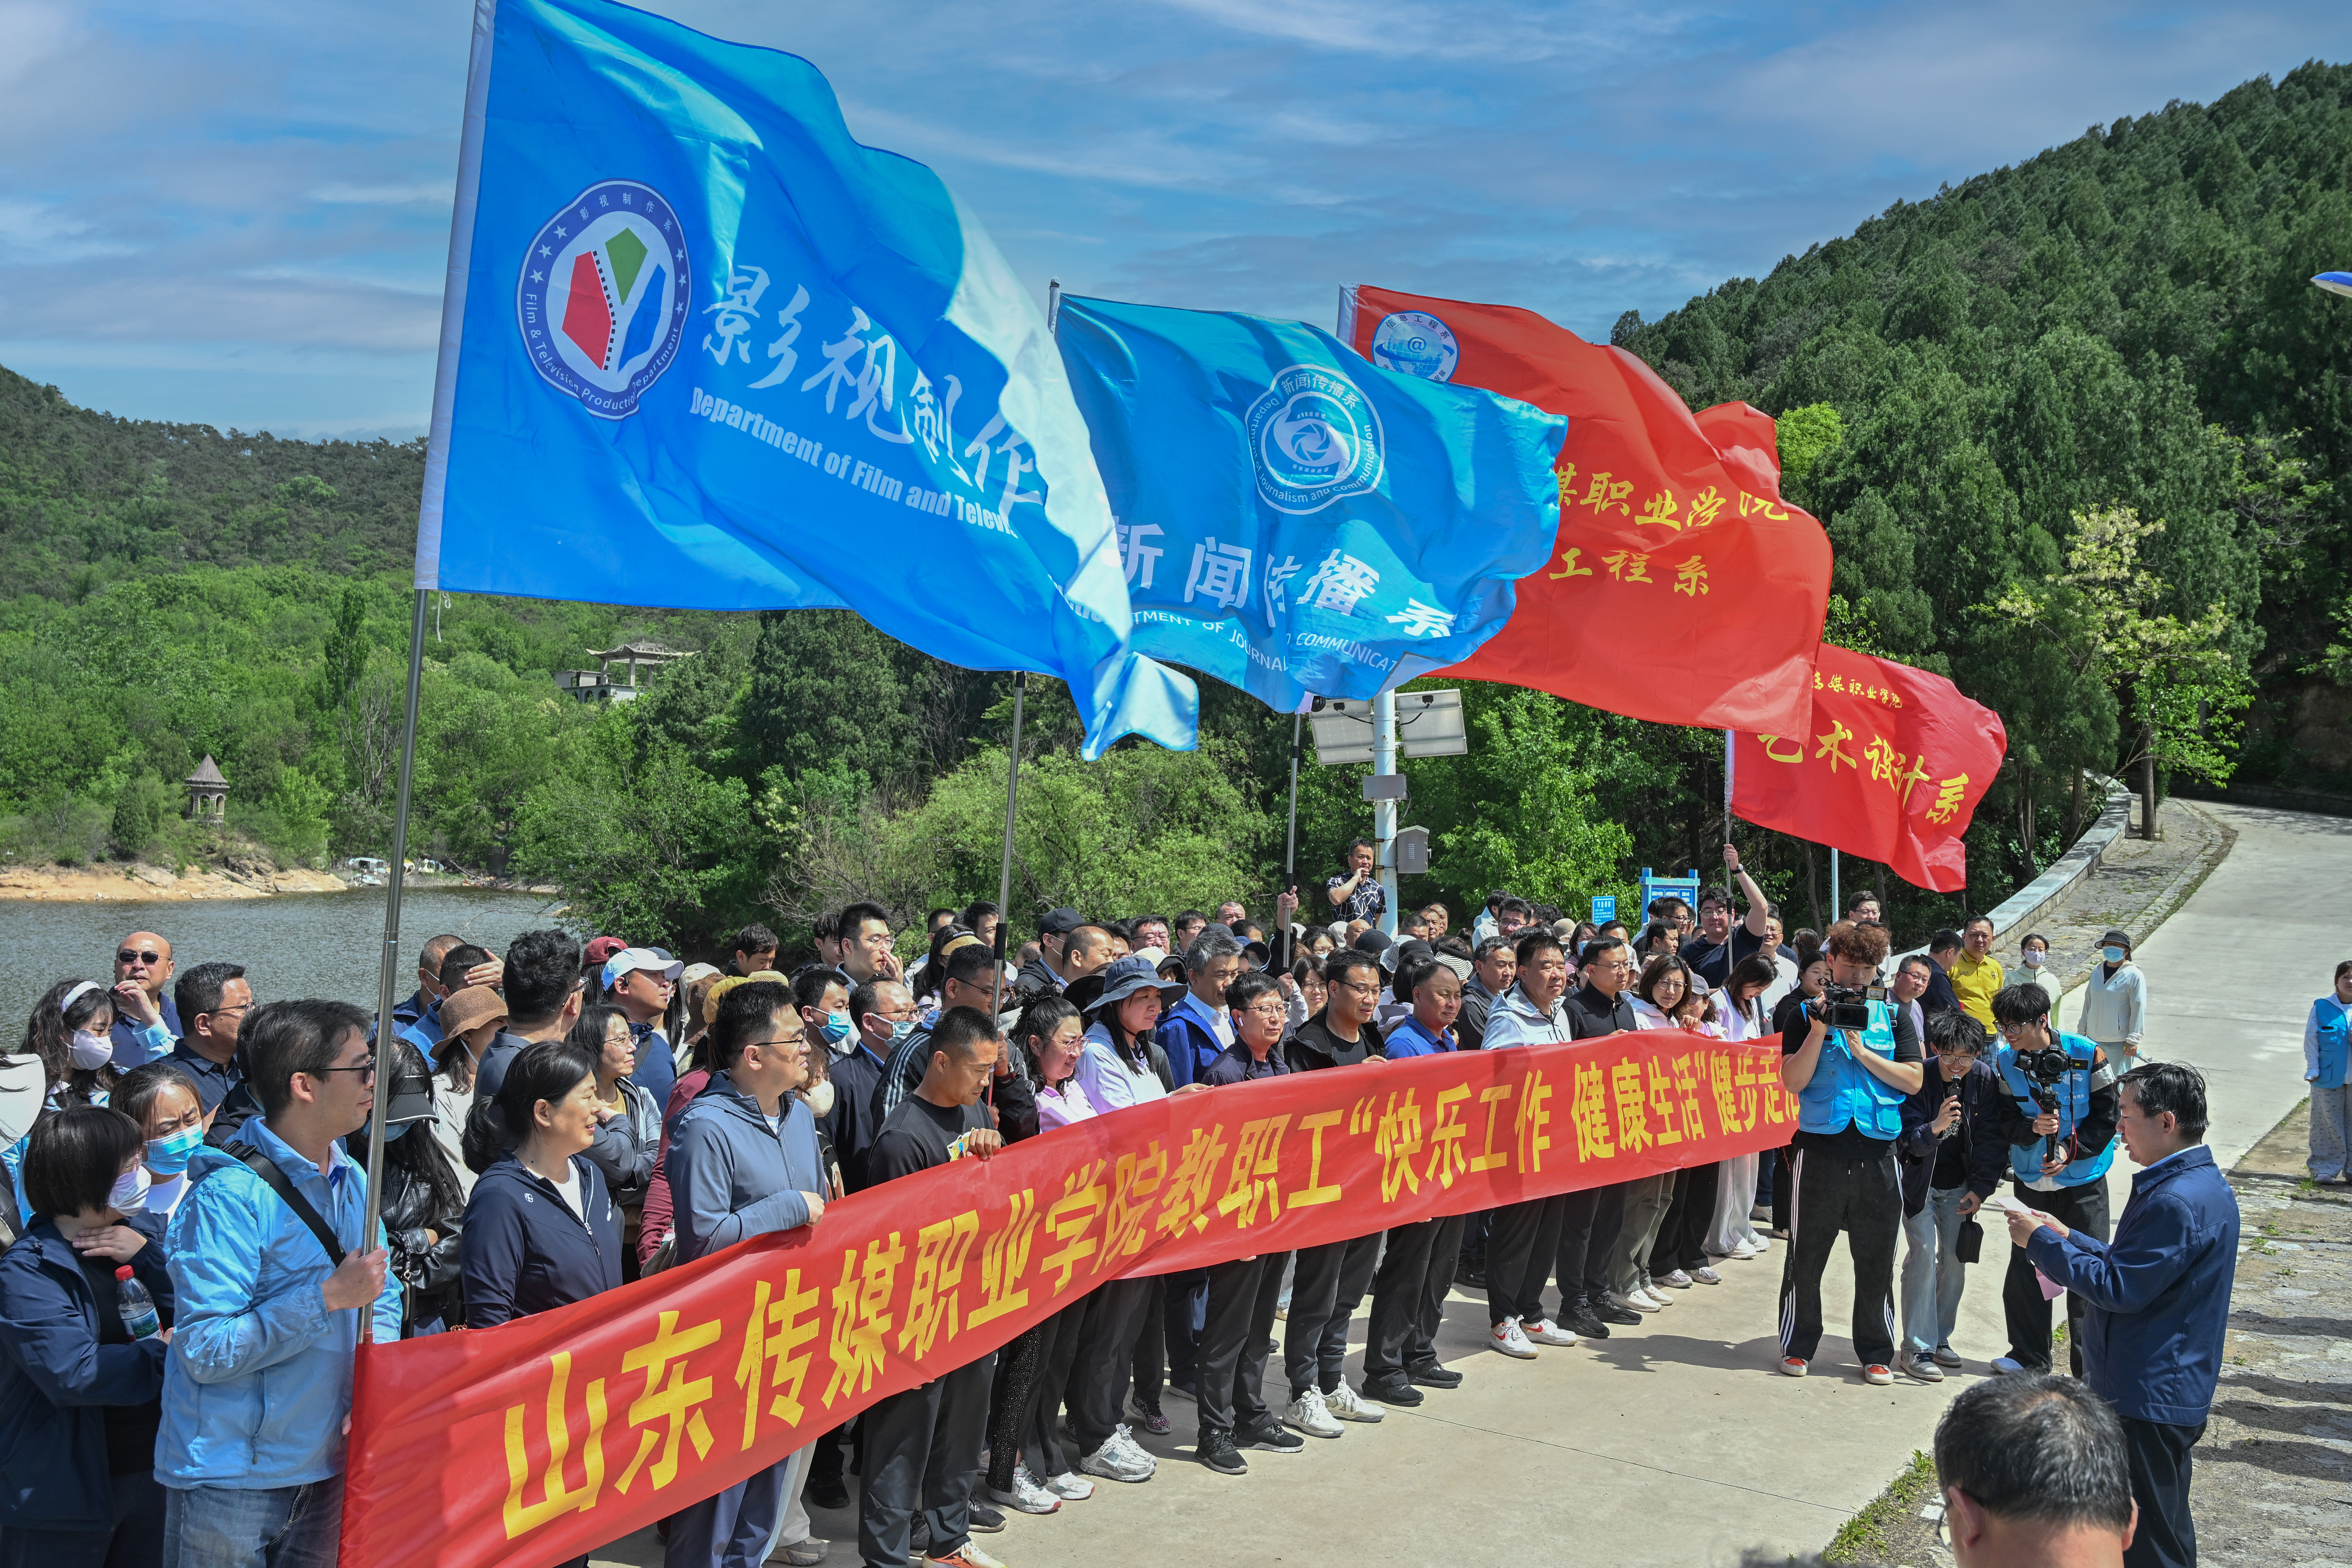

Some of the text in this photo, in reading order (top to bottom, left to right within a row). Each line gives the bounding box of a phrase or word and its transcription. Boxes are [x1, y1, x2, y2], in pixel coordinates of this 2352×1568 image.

[580, 192, 672, 231] 影视制作系
[1386, 315, 1451, 339] 信息工程系
[526, 294, 678, 410] Film & Television Production Department
[1281, 373, 1360, 410] 新闻传播系
[1251, 397, 1279, 458] Department
[690, 387, 822, 467] Department
[824, 452, 852, 480] of
[851, 460, 903, 502] Film
[905, 486, 951, 517] and
[1256, 461, 1262, 472] of
[1332, 425, 1374, 491] Communication
[1259, 472, 1308, 503] Journalism
[1549, 548, 1709, 596] 工程系
[1202, 622, 1225, 633] OF
